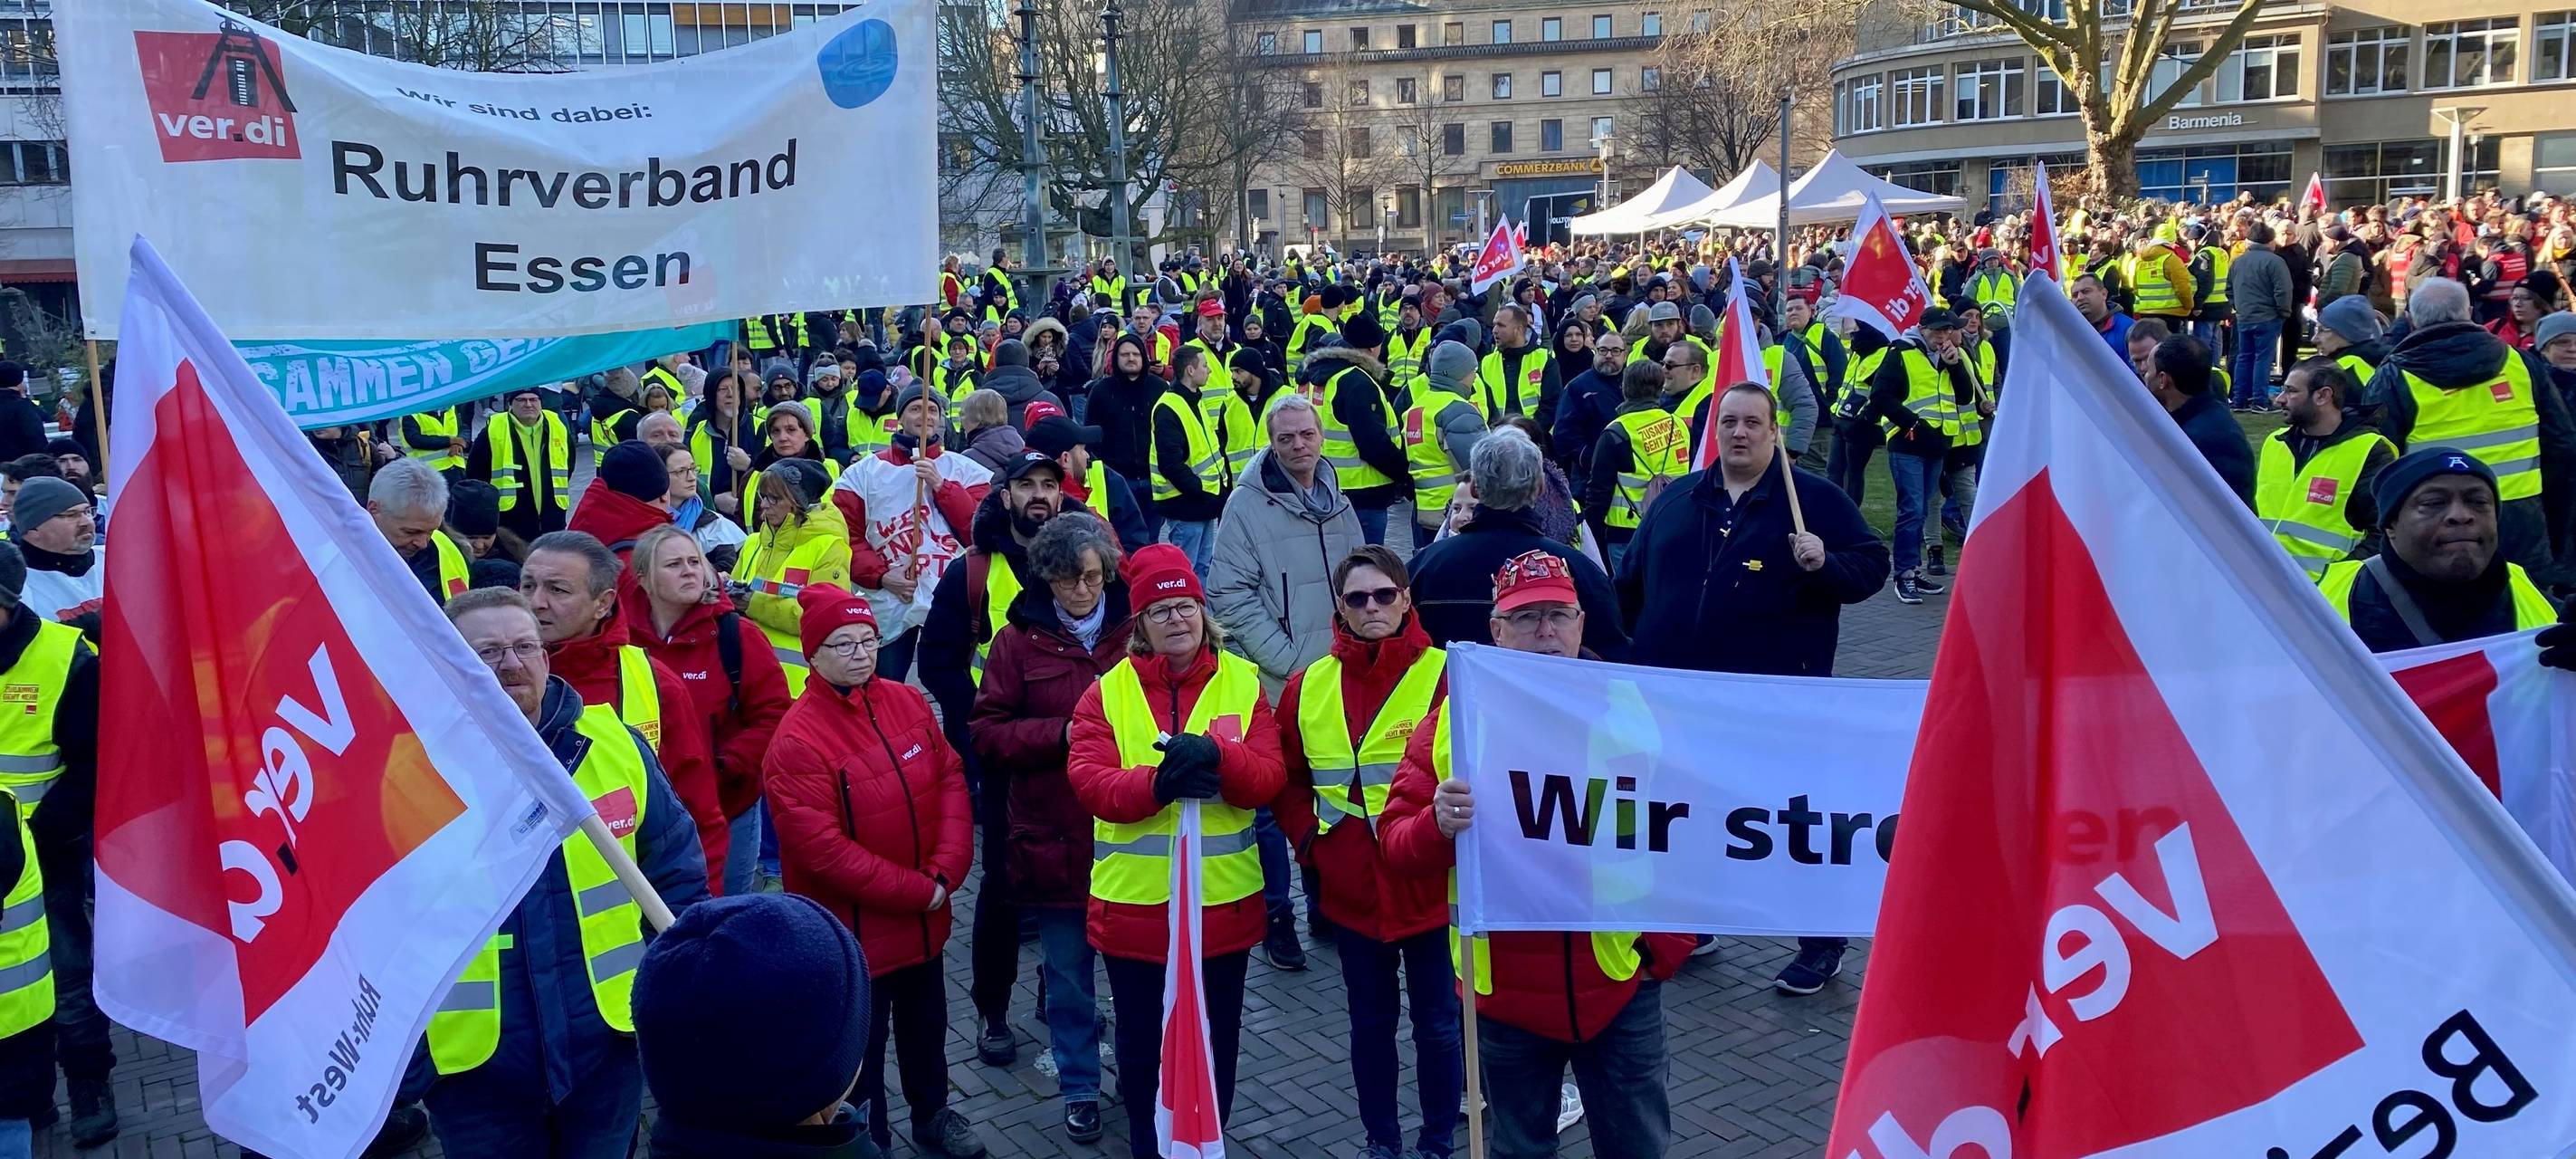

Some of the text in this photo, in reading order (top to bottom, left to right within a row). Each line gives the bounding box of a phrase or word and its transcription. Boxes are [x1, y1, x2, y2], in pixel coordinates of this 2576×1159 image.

[396, 87, 654, 123] Wir sind dabei:
[158, 110, 287, 147] ver.di
[2169, 112, 2242, 129] Barmenia
[331, 138, 797, 209] Ruhrverband
[1496, 161, 1587, 175] COMMERZBANK
[474, 242, 692, 294] Essen
[1644, 435, 1664, 453] GEHT
[2309, 492, 2333, 503] ver.di
[1156, 578, 1187, 589] ver.di
[682, 670, 707, 680] ver.di
[902, 743, 922, 761] ver.di
[1508, 770, 1690, 853] Wir
